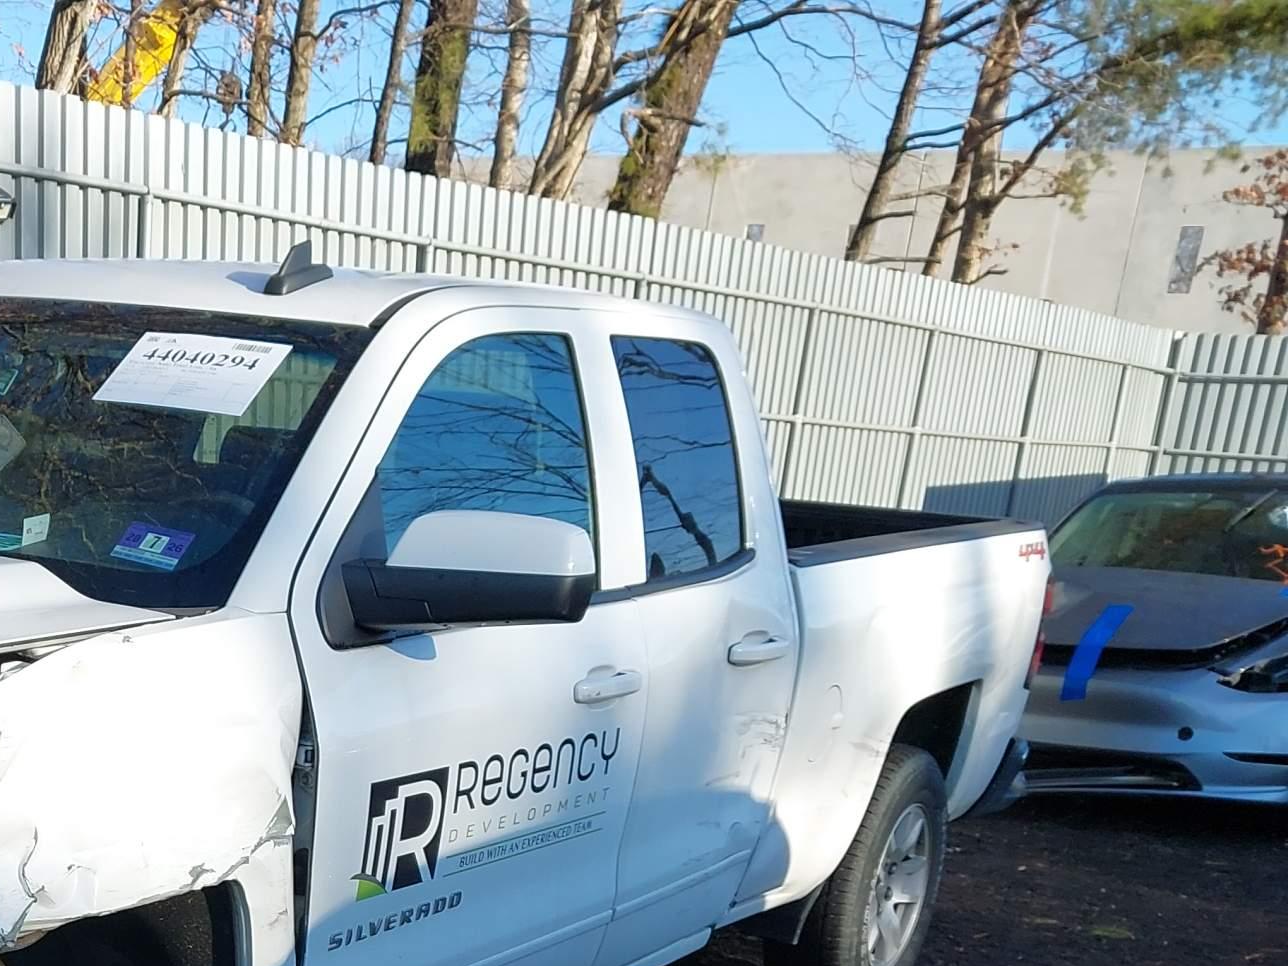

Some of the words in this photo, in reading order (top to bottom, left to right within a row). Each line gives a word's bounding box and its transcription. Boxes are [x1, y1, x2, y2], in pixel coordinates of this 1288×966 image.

[143, 347, 260, 371] 44040294
[149, 535, 162, 549] 7
[167, 542, 184, 554] 26
[447, 786, 610, 843] DEVELOPMENT
[459, 850, 485, 868] BUILD
[486, 844, 508, 859] WITH
[327, 890, 463, 951] SILVERADO
